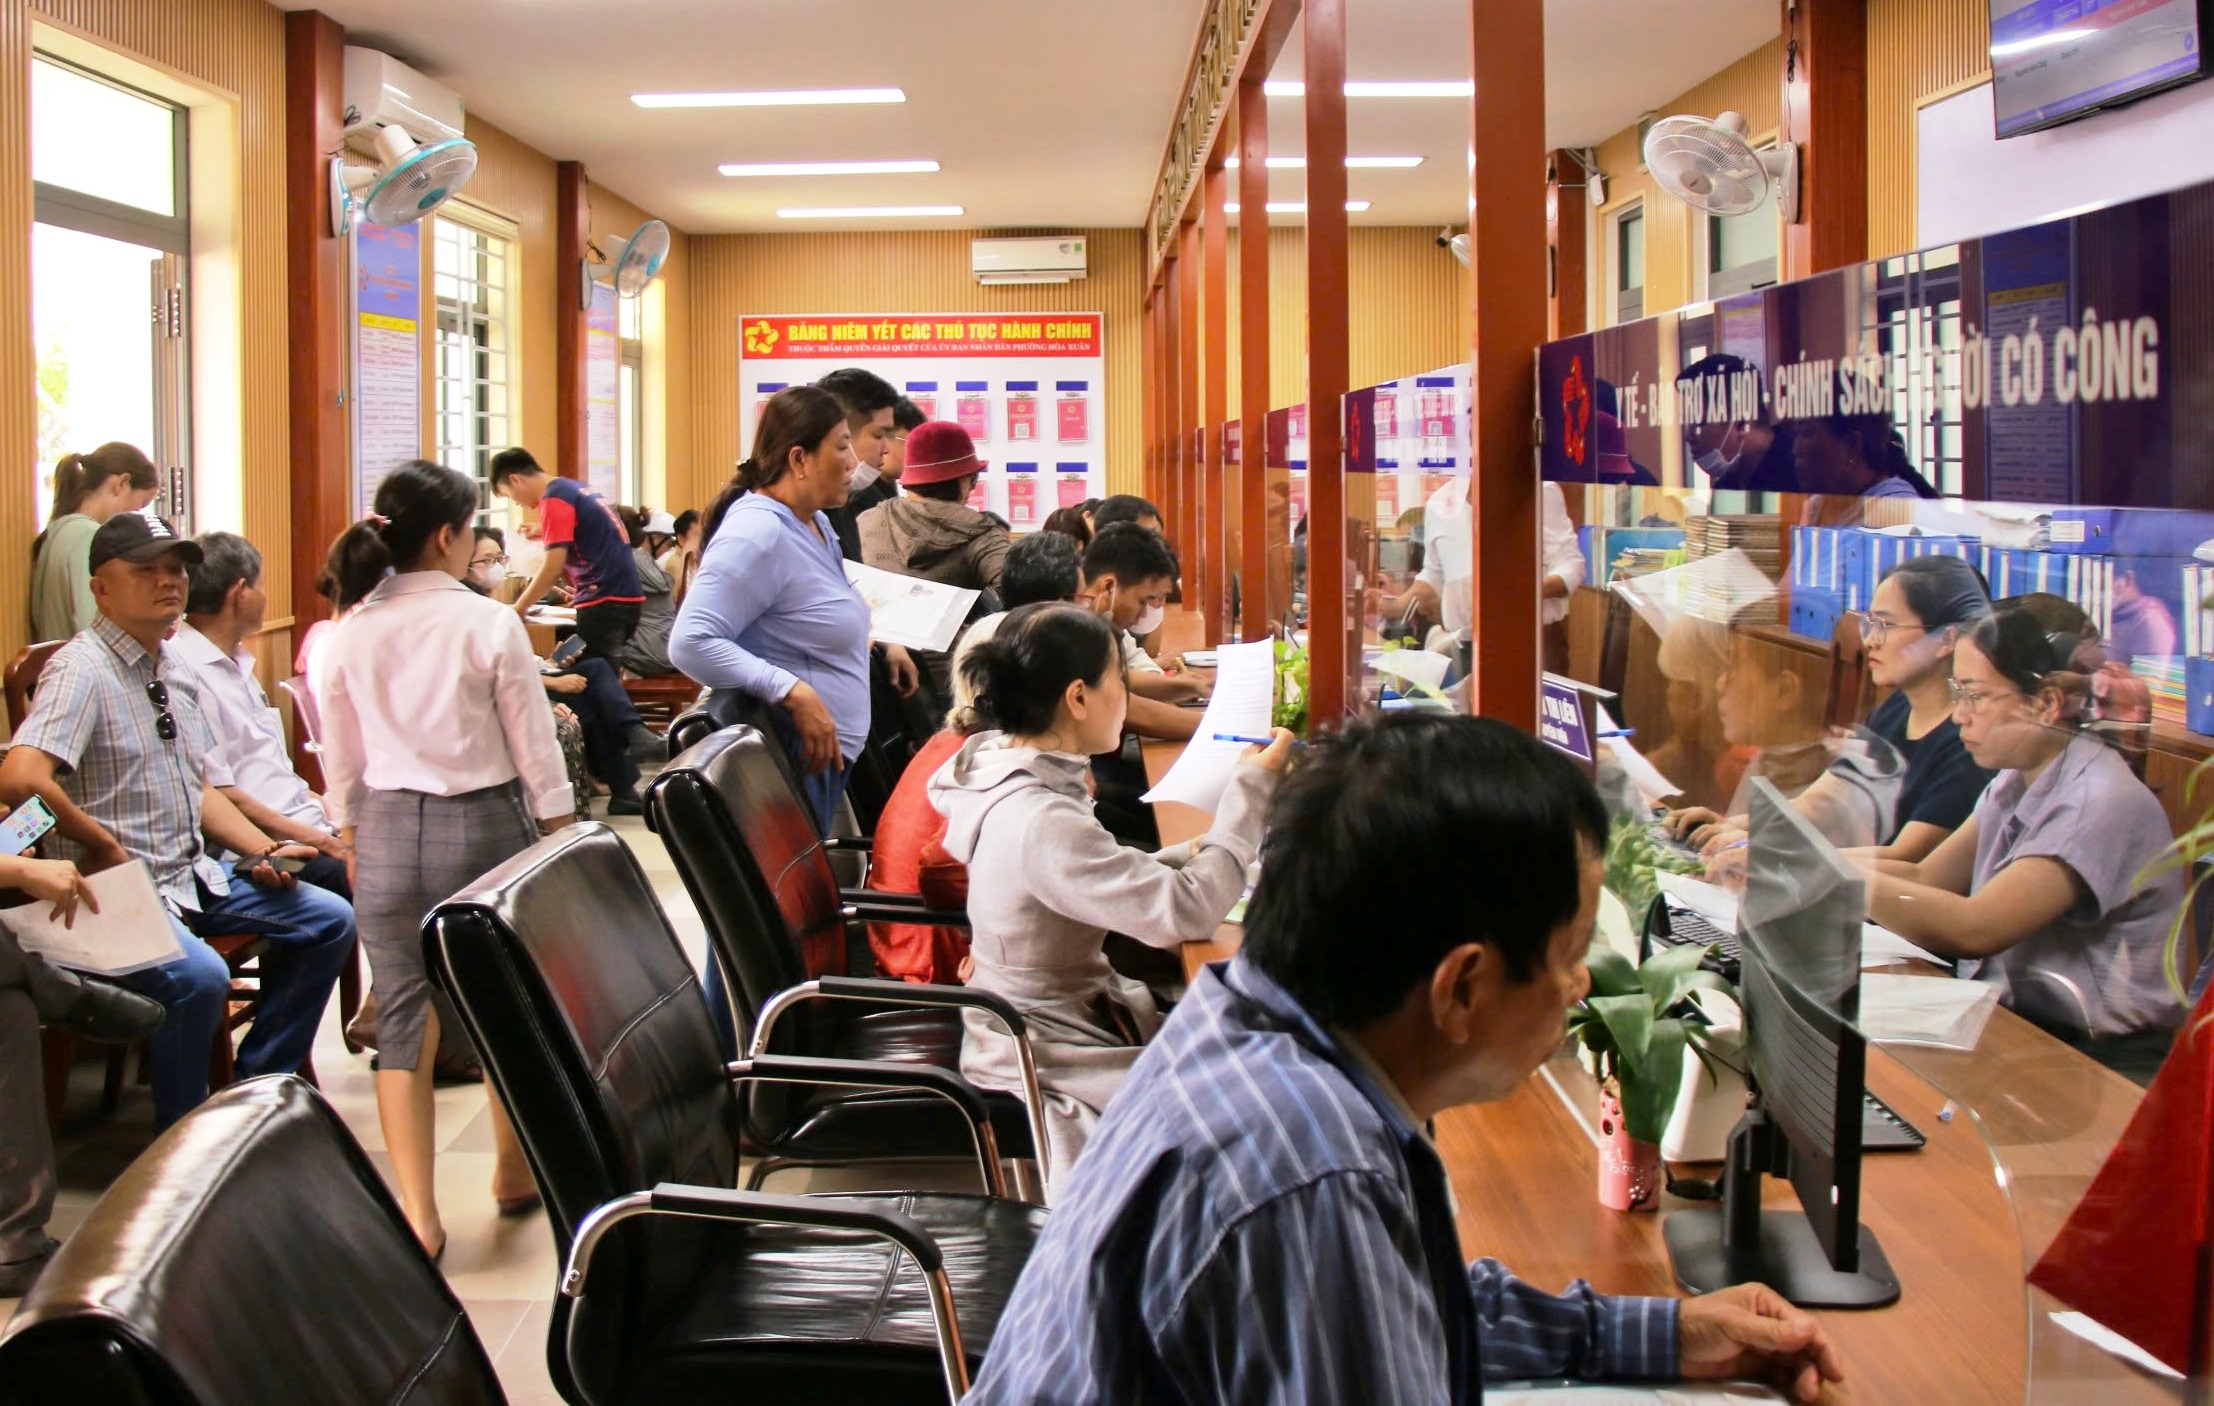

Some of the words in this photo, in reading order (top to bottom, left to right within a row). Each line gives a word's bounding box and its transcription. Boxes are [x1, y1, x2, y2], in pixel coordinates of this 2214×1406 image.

[789, 321, 828, 341] BẢNG
[832, 322, 868, 340] NIÊM
[872, 319, 897, 340] YẾT
[901, 321, 931, 340] CÁC
[935, 320, 964, 340] THỦ
[968, 323, 998, 341] TỤC
[1002, 320, 1041, 339] HÀNH
[1046, 320, 1092, 339] CHÍNH
[994, 342, 1012, 351] DÂN
[1013, 342, 1047, 351] PHƯỜNG
[1068, 342, 1090, 351] XUÂN
[1615, 387, 1623, 429] Y
[1625, 371, 1639, 428] TẾ
[1677, 371, 1704, 435] TRỢ
[1707, 364, 1728, 424] XÃ
[1731, 359, 1759, 433] HỘI
[1774, 350, 1833, 419] CHÍNH
[1903, 323, 1990, 409] GỜI
[2002, 315, 2044, 406] CÓ
[2055, 306, 2159, 404] CÔNG
